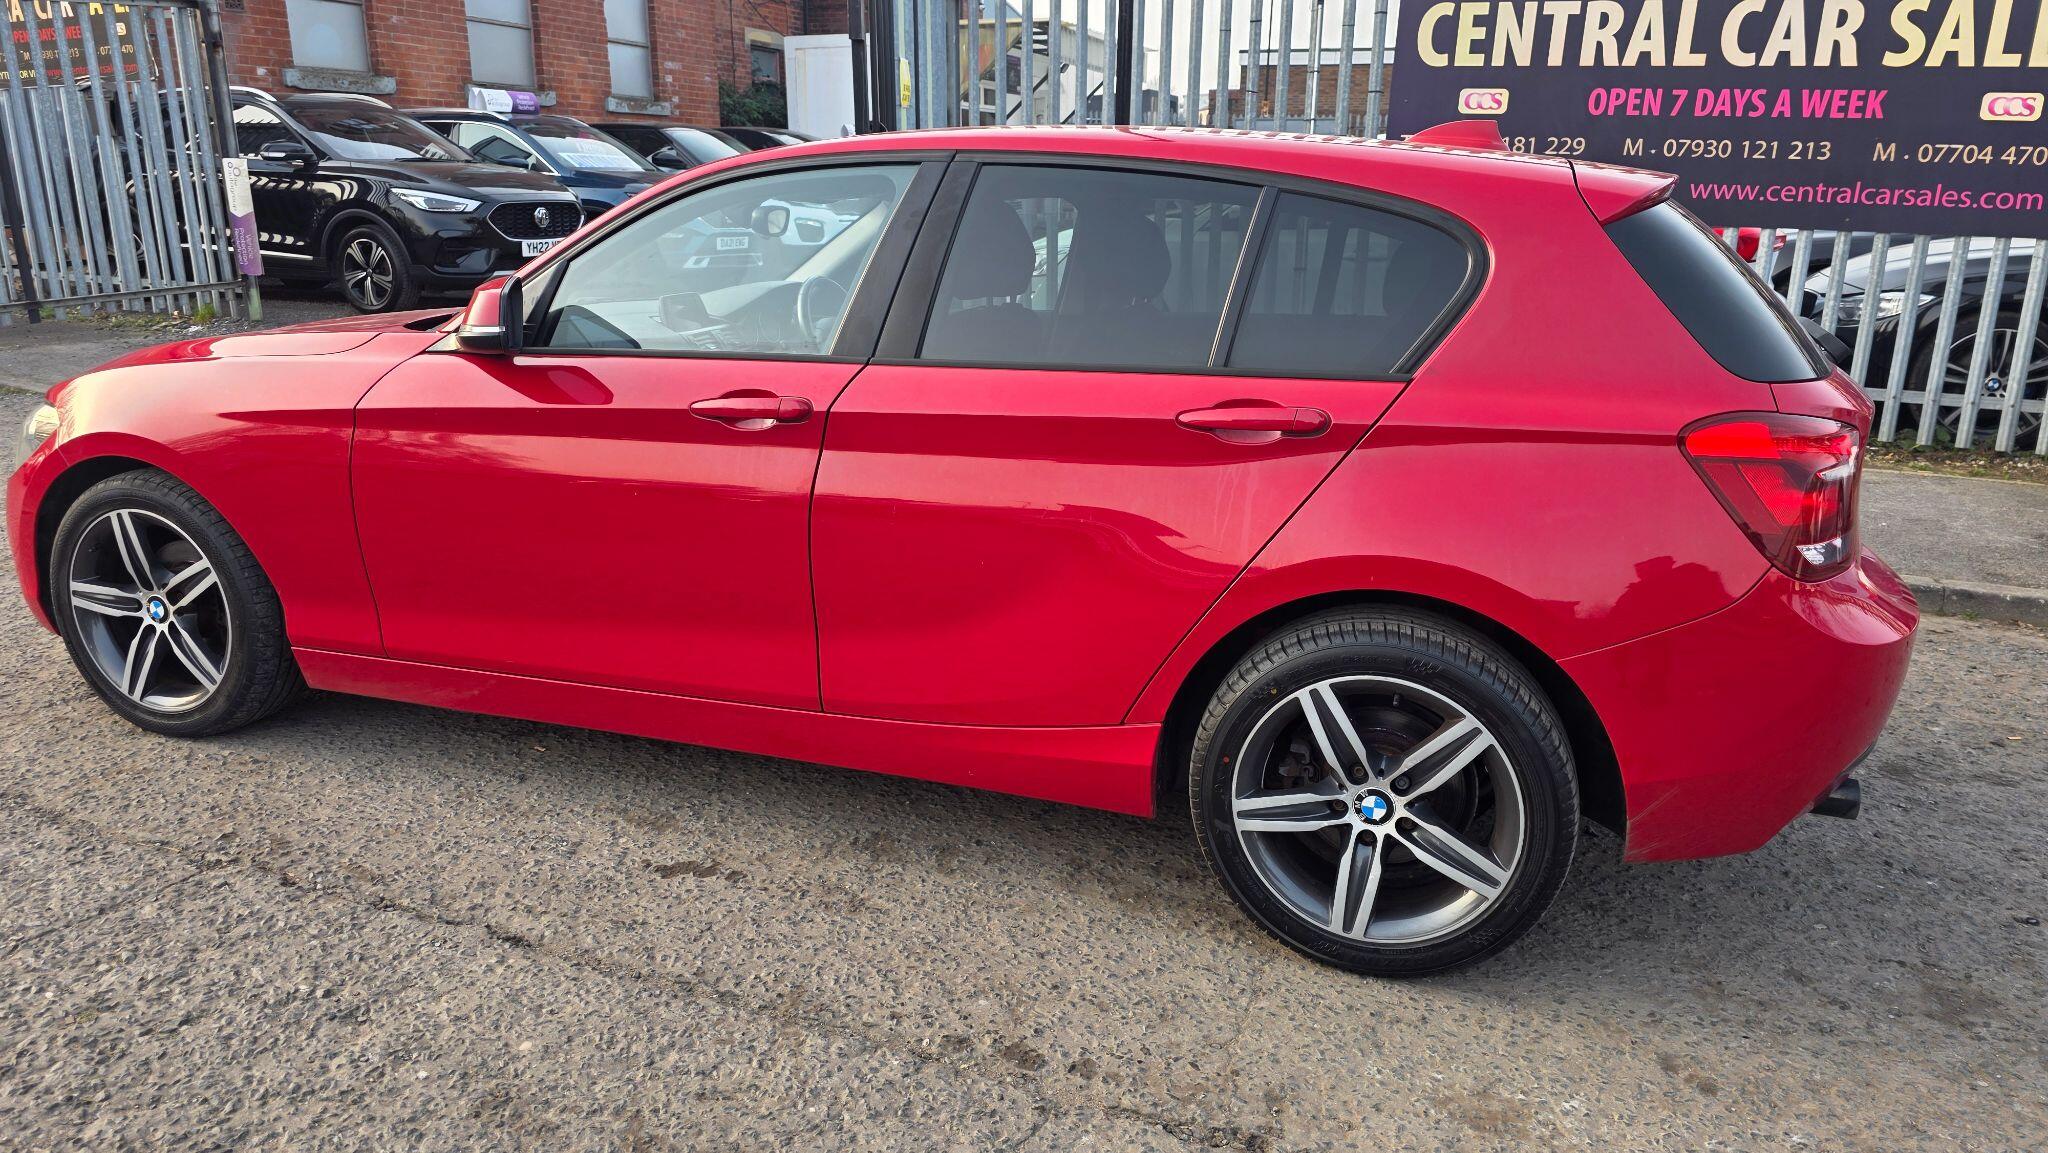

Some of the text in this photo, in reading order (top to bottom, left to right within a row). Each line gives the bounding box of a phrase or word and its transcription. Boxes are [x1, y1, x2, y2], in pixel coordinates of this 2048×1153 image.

[1417, 0, 1706, 67] CENTRAL
[1720, 0, 1865, 67] CAR
[1464, 92, 1503, 110] CCS
[1588, 88, 1888, 118] OPEN 7 DAYS A WEEK
[1987, 96, 2037, 117] CCS
[1543, 136, 1586, 155] 229
[1622, 138, 1644, 156] M
[1663, 138, 1732, 159] 07930
[1742, 140, 1778, 160] 121
[1788, 140, 1831, 161] 213
[1872, 142, 1896, 162] M
[1917, 143, 1993, 164] 07704
[2000, 146, 2048, 166] 470
[1690, 181, 2044, 210] www.centralcarsales.com
[527, 241, 549, 254] YH22
